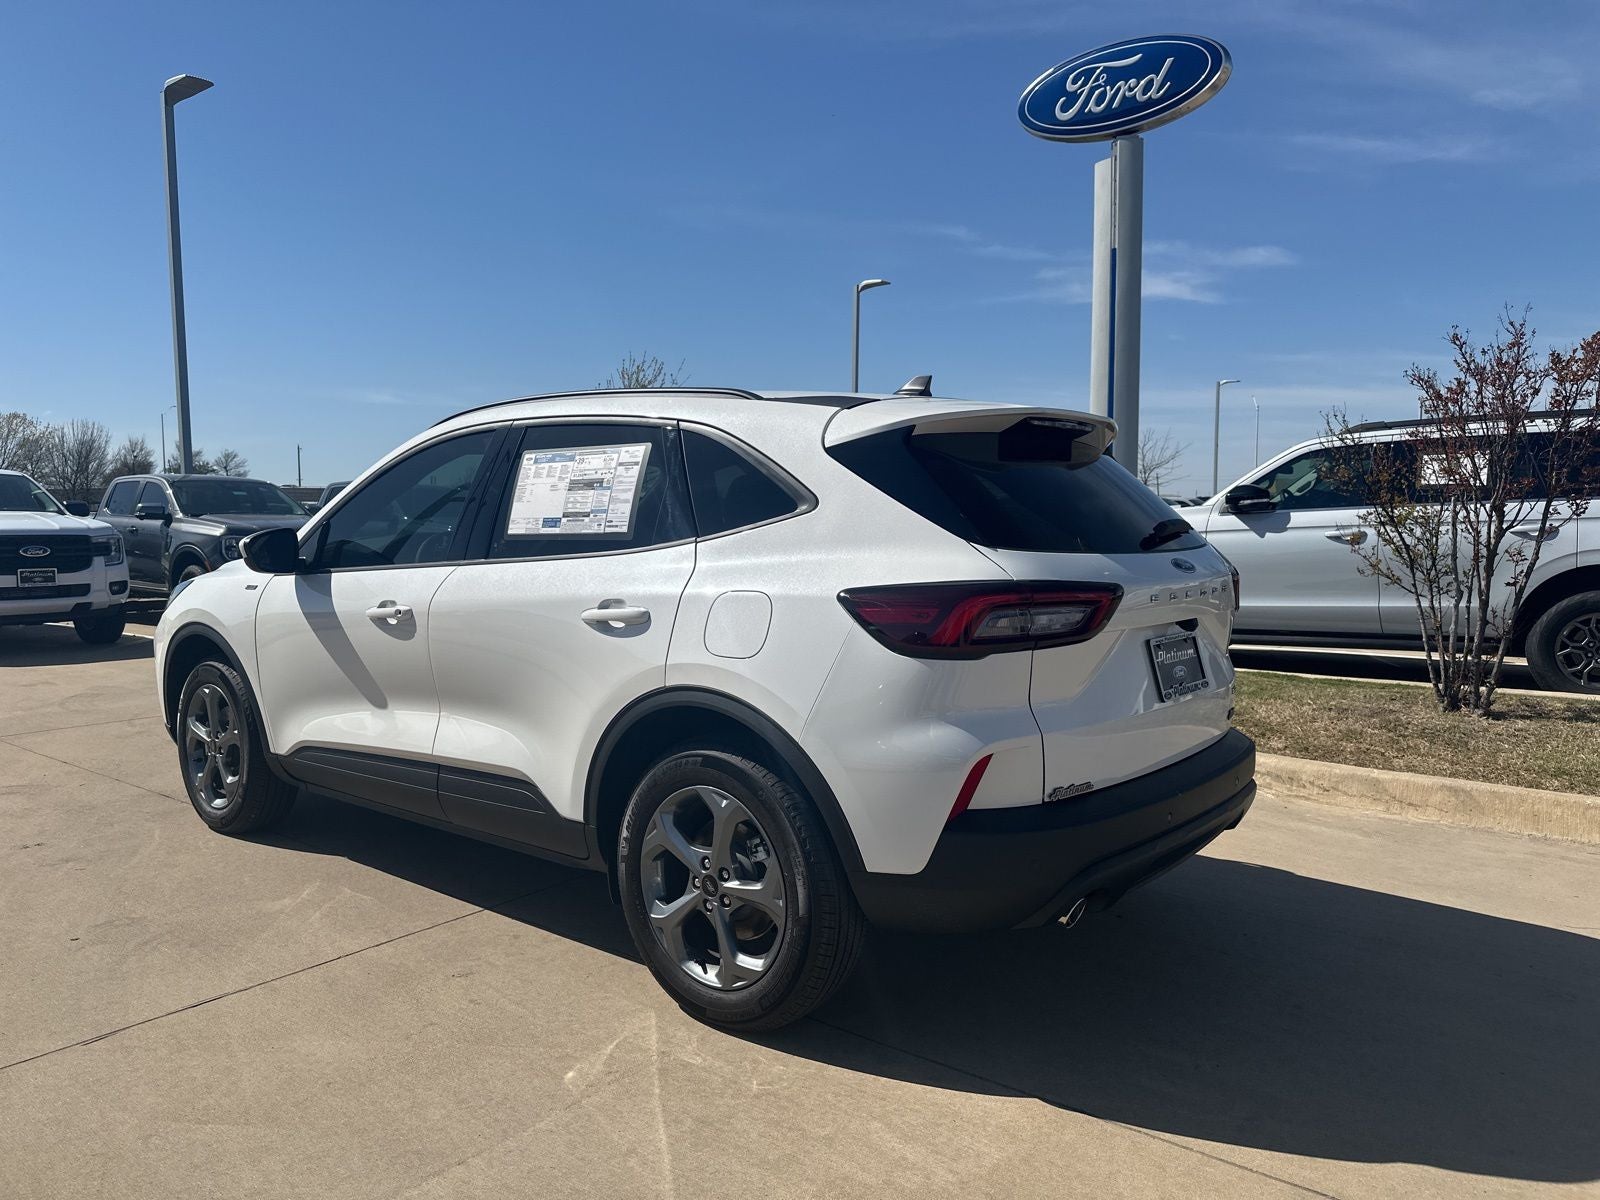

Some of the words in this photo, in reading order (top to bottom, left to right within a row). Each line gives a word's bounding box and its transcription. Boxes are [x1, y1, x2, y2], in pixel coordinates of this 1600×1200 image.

[1055, 53, 1175, 121] Ford
[27, 547, 44, 555] Ford
[1150, 585, 1227, 603] ESCAPE
[1156, 648, 1197, 664] Platinum
